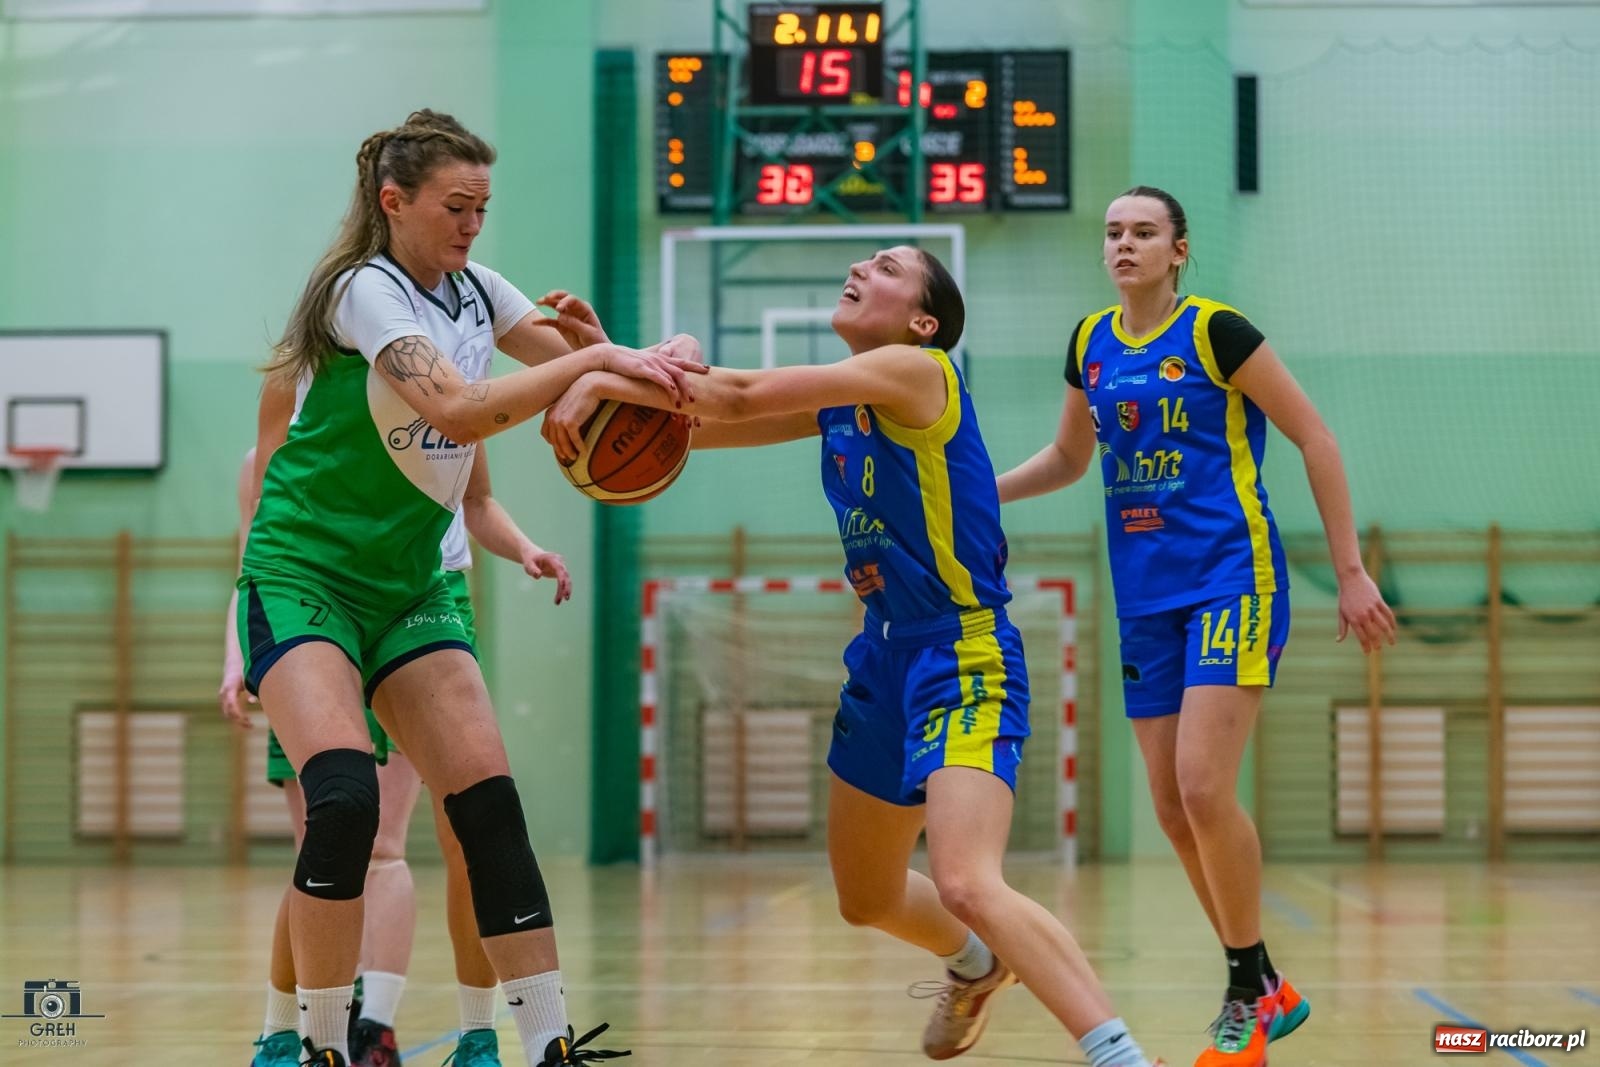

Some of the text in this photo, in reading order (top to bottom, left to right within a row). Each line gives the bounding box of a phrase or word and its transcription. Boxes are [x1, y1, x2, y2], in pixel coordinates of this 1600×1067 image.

[799, 50, 852, 96] 15
[929, 162, 986, 204] 35
[1157, 396, 1189, 433] 14
[862, 455, 875, 497] 8
[300, 598, 333, 627] 7
[1200, 608, 1236, 657] 14
[1198, 658, 1233, 666] COLO
